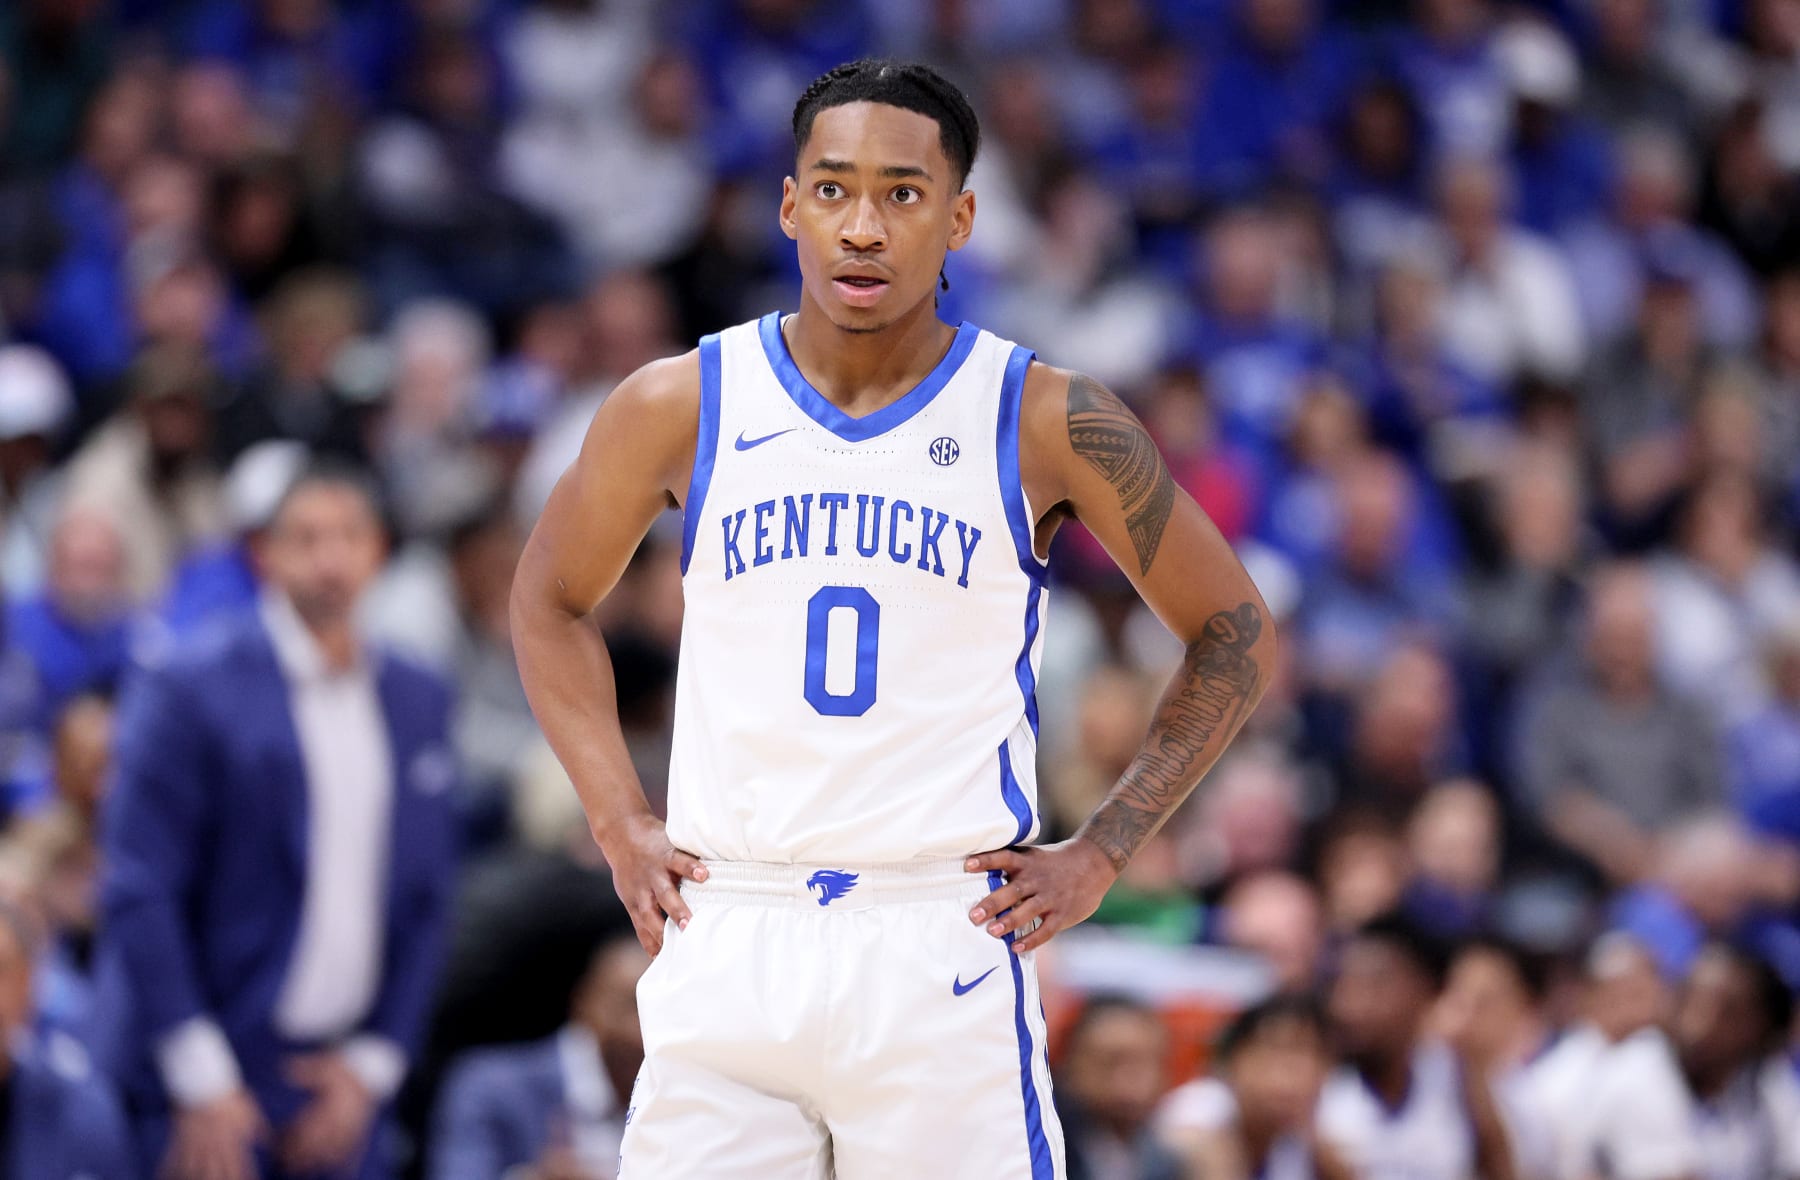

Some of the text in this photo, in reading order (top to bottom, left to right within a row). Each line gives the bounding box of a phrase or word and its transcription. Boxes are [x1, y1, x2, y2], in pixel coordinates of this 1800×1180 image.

[930, 437, 959, 465] SEC
[721, 493, 982, 589] KENTUCKY
[803, 585, 881, 717] 0
